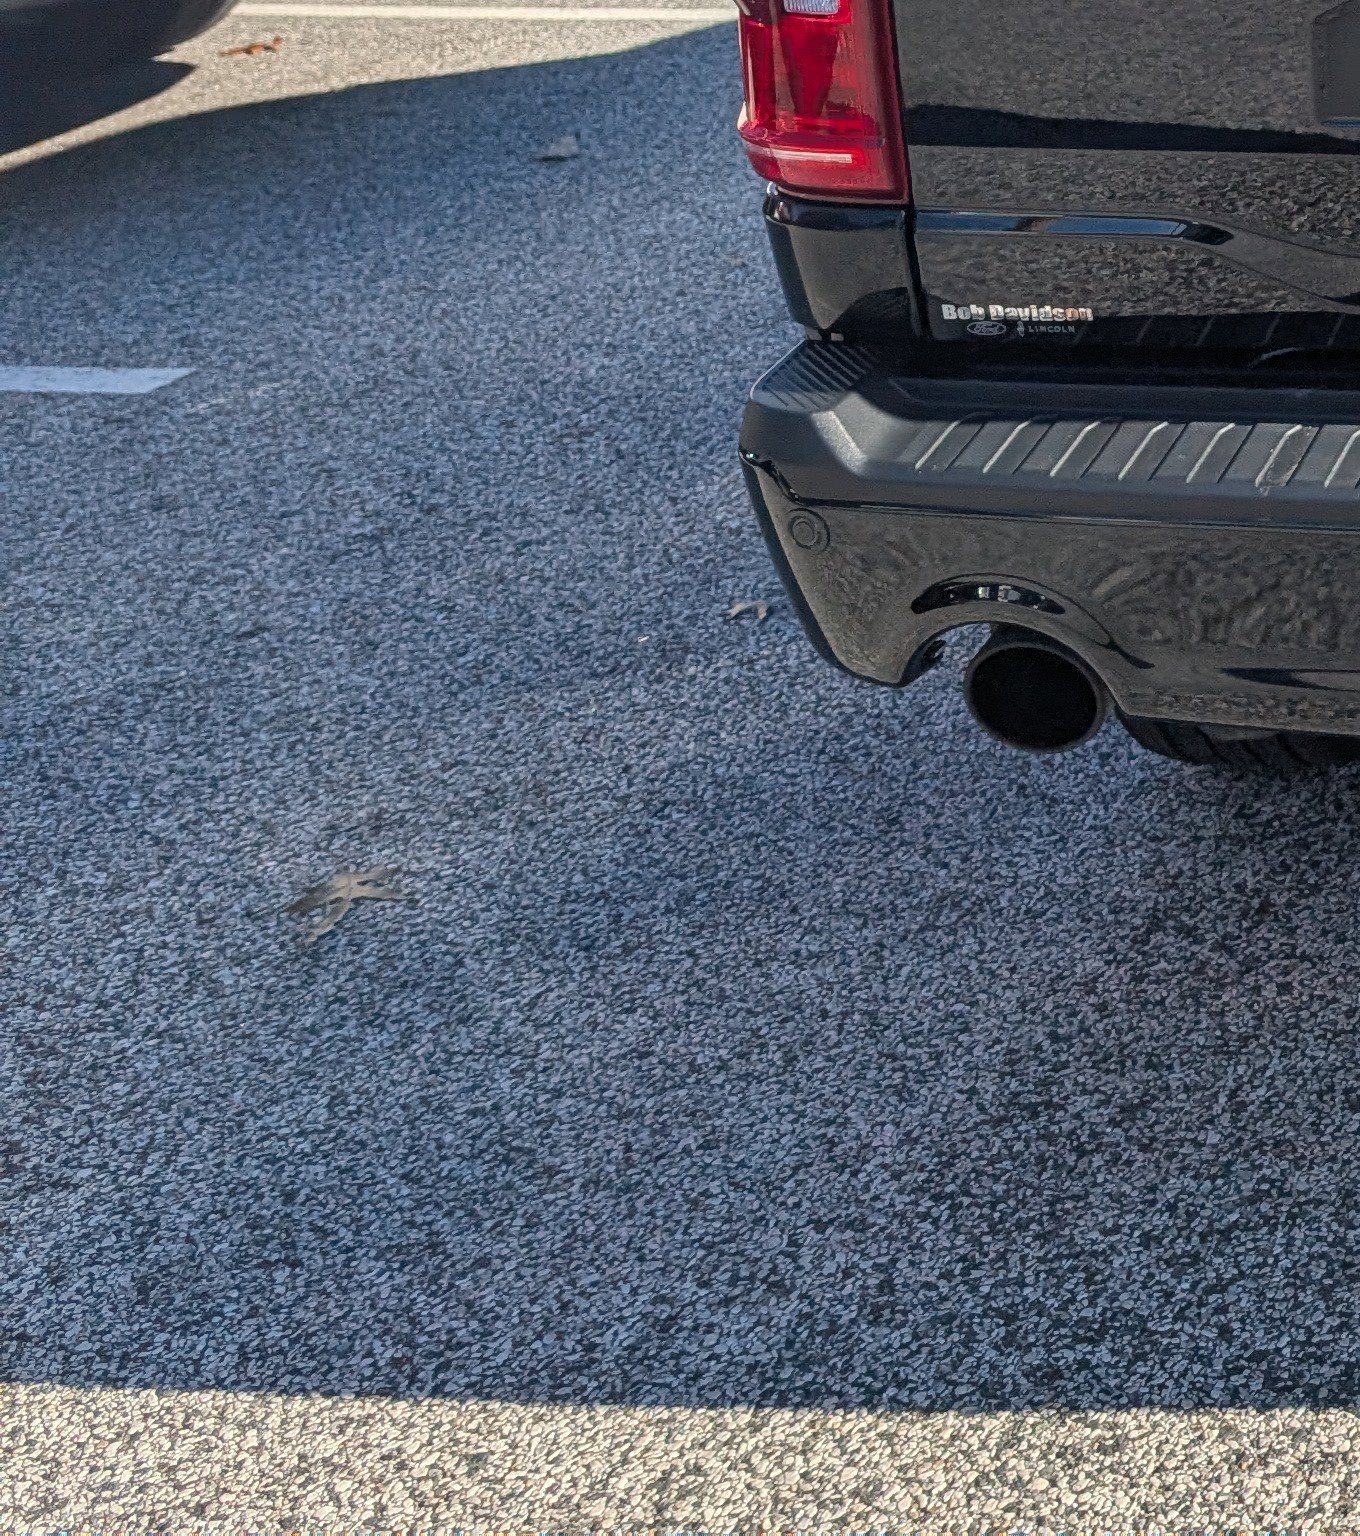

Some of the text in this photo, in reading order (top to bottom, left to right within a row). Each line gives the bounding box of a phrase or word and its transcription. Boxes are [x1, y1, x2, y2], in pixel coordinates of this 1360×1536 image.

[941, 304, 1093, 321] Bob Davidson
[1028, 325, 1075, 333] LINCOLN
